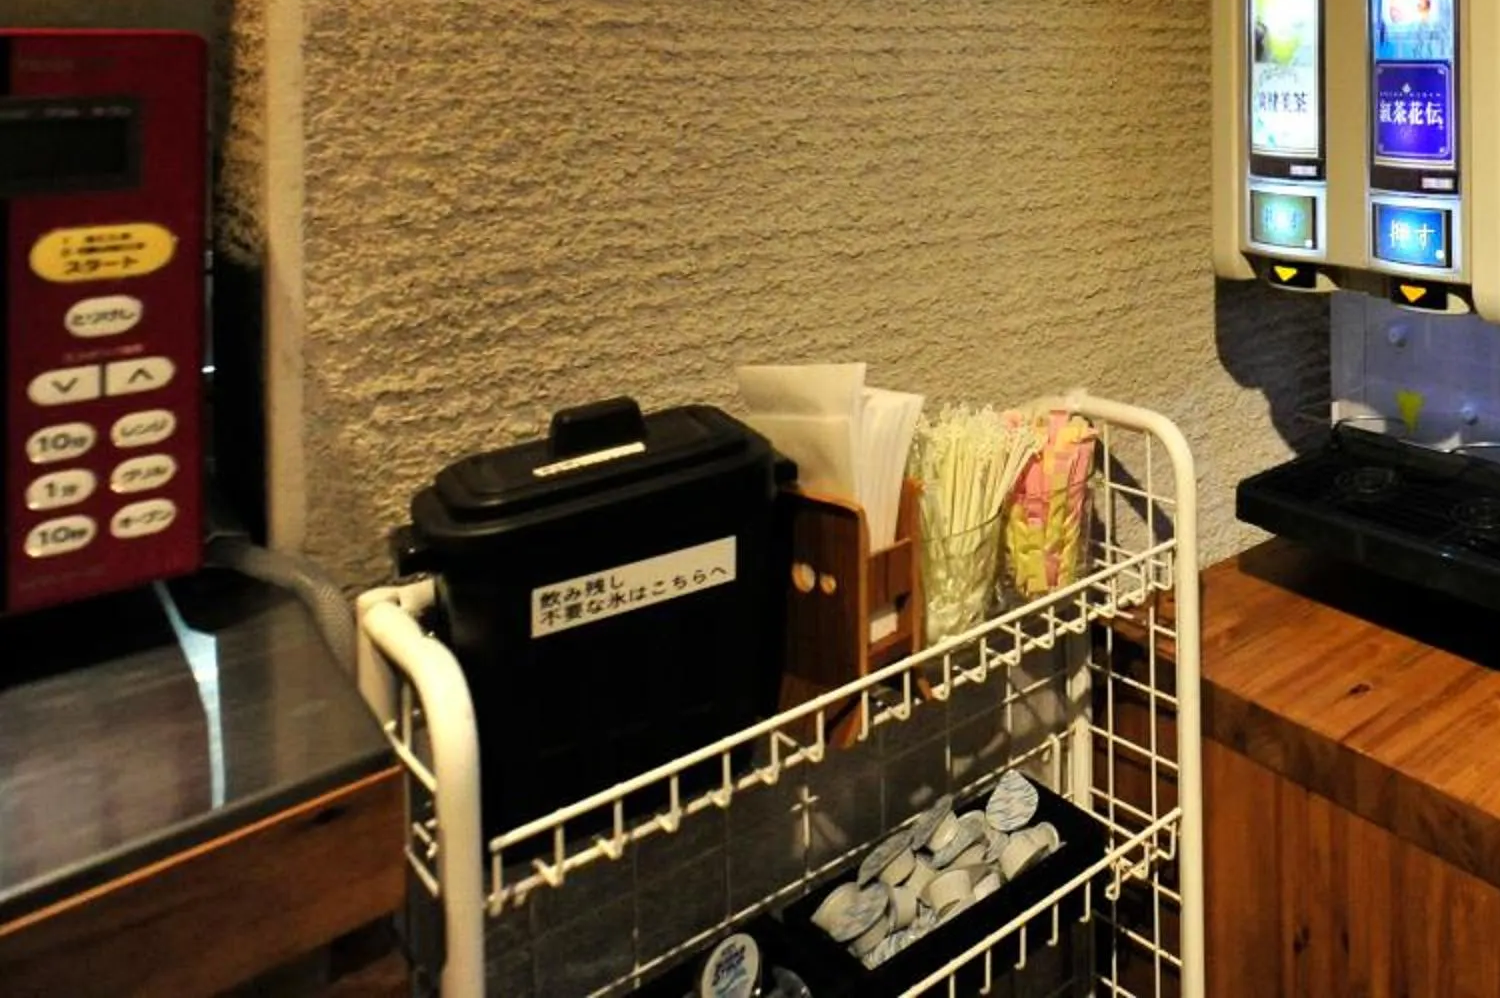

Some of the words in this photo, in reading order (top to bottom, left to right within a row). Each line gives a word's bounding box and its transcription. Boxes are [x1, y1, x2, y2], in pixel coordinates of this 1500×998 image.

[1379, 100, 1444, 127] 紅茶花伝
[539, 574, 625, 610] 飲み残し
[539, 565, 727, 627] 不要な氷はこちらへ
